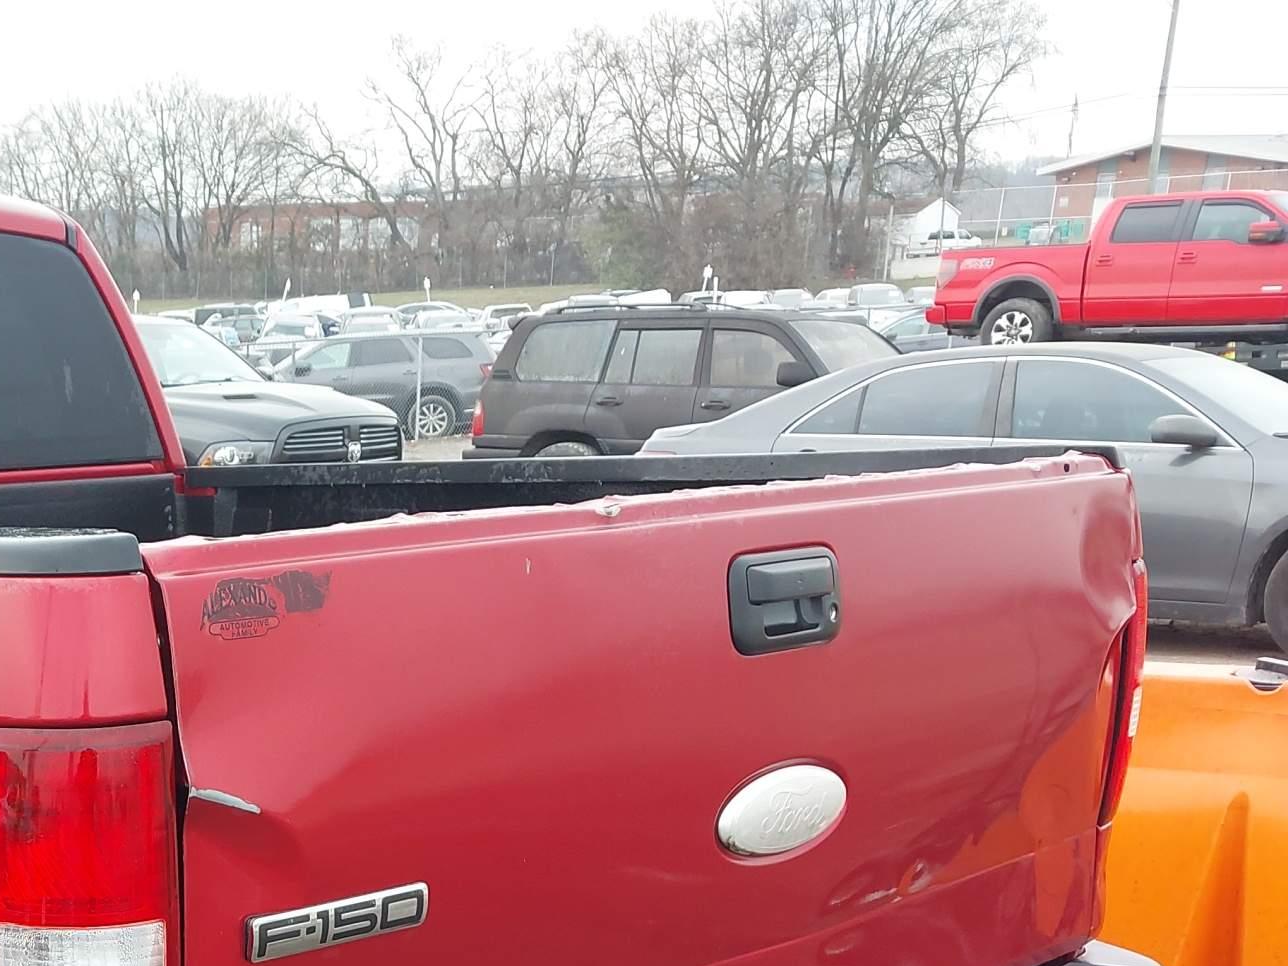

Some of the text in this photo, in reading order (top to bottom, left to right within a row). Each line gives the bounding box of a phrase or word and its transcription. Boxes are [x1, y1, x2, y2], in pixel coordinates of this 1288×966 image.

[220, 618, 270, 631] AUTOMOTIVE
[760, 784, 827, 834] Ford
[257, 889, 424, 958] F-150
